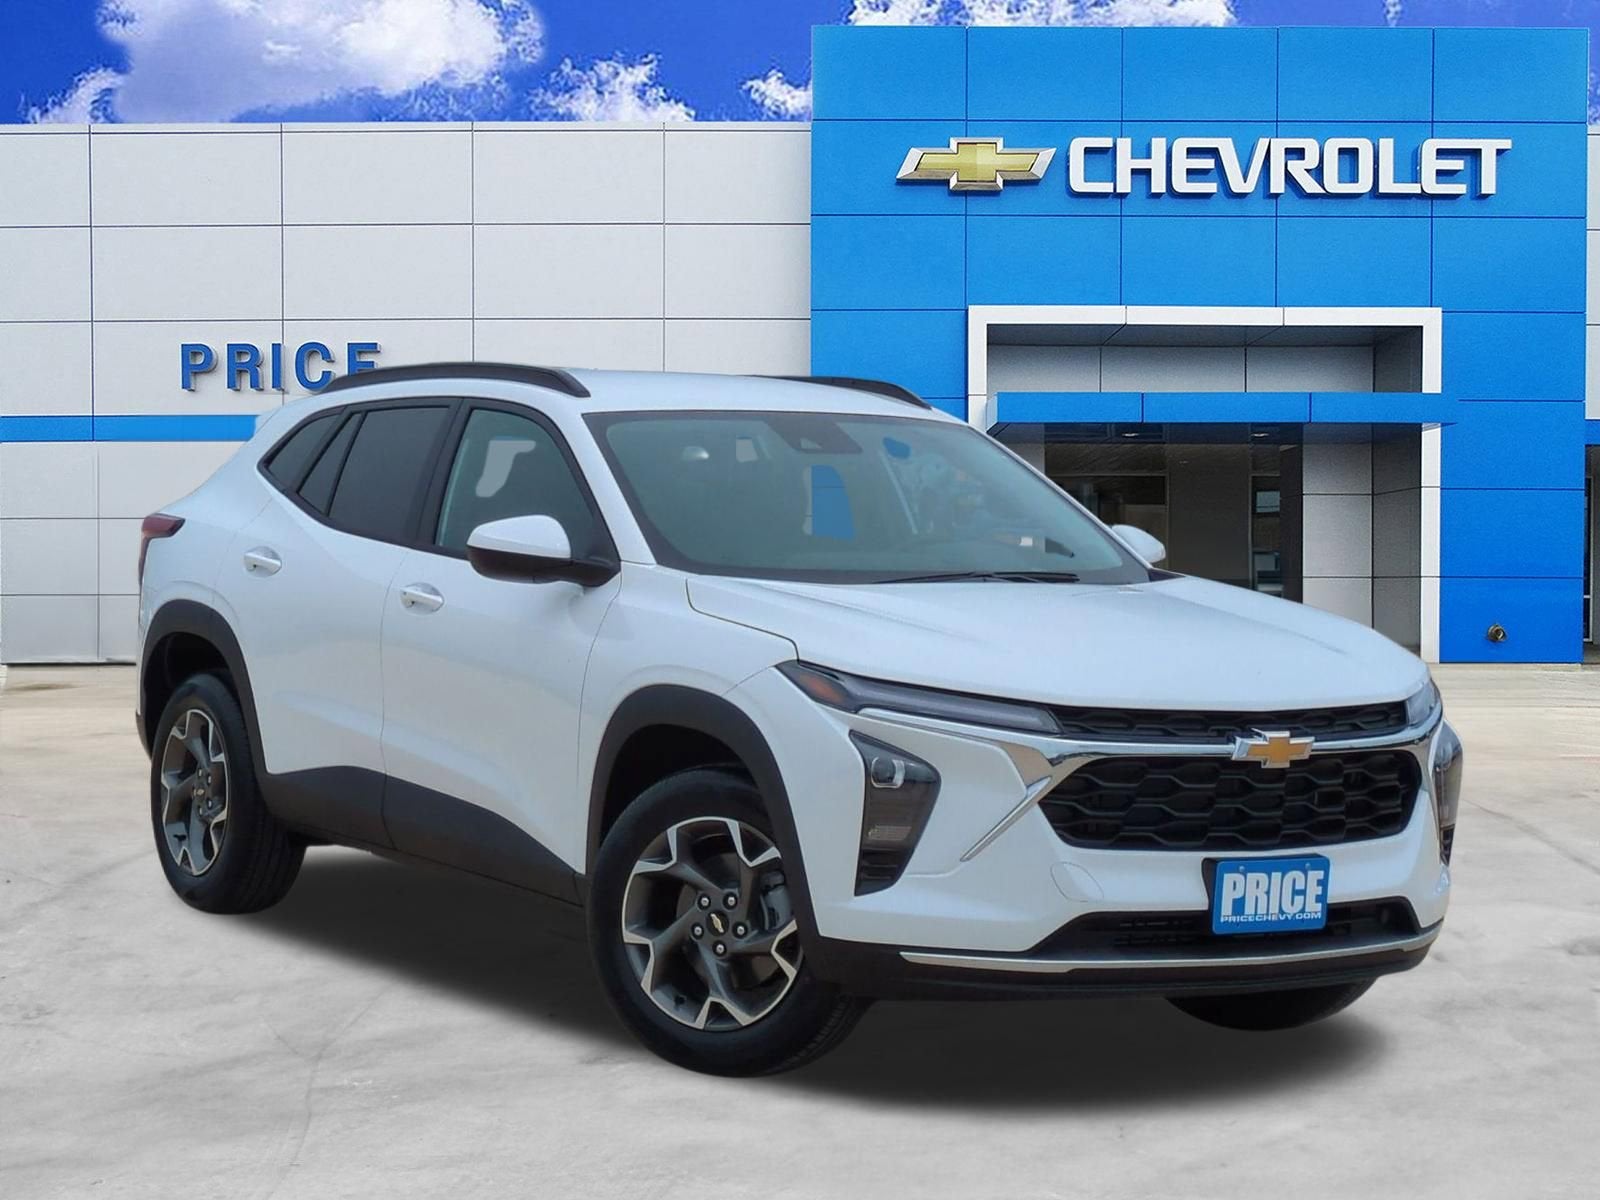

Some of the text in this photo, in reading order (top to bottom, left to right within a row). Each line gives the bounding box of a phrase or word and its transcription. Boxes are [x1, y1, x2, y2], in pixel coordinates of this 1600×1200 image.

[1068, 137, 1513, 197] CHEVROLET
[180, 341, 381, 392] PRICE
[1221, 870, 1325, 916] PRICE
[1220, 912, 1322, 923] PRICECHEVY.COM
